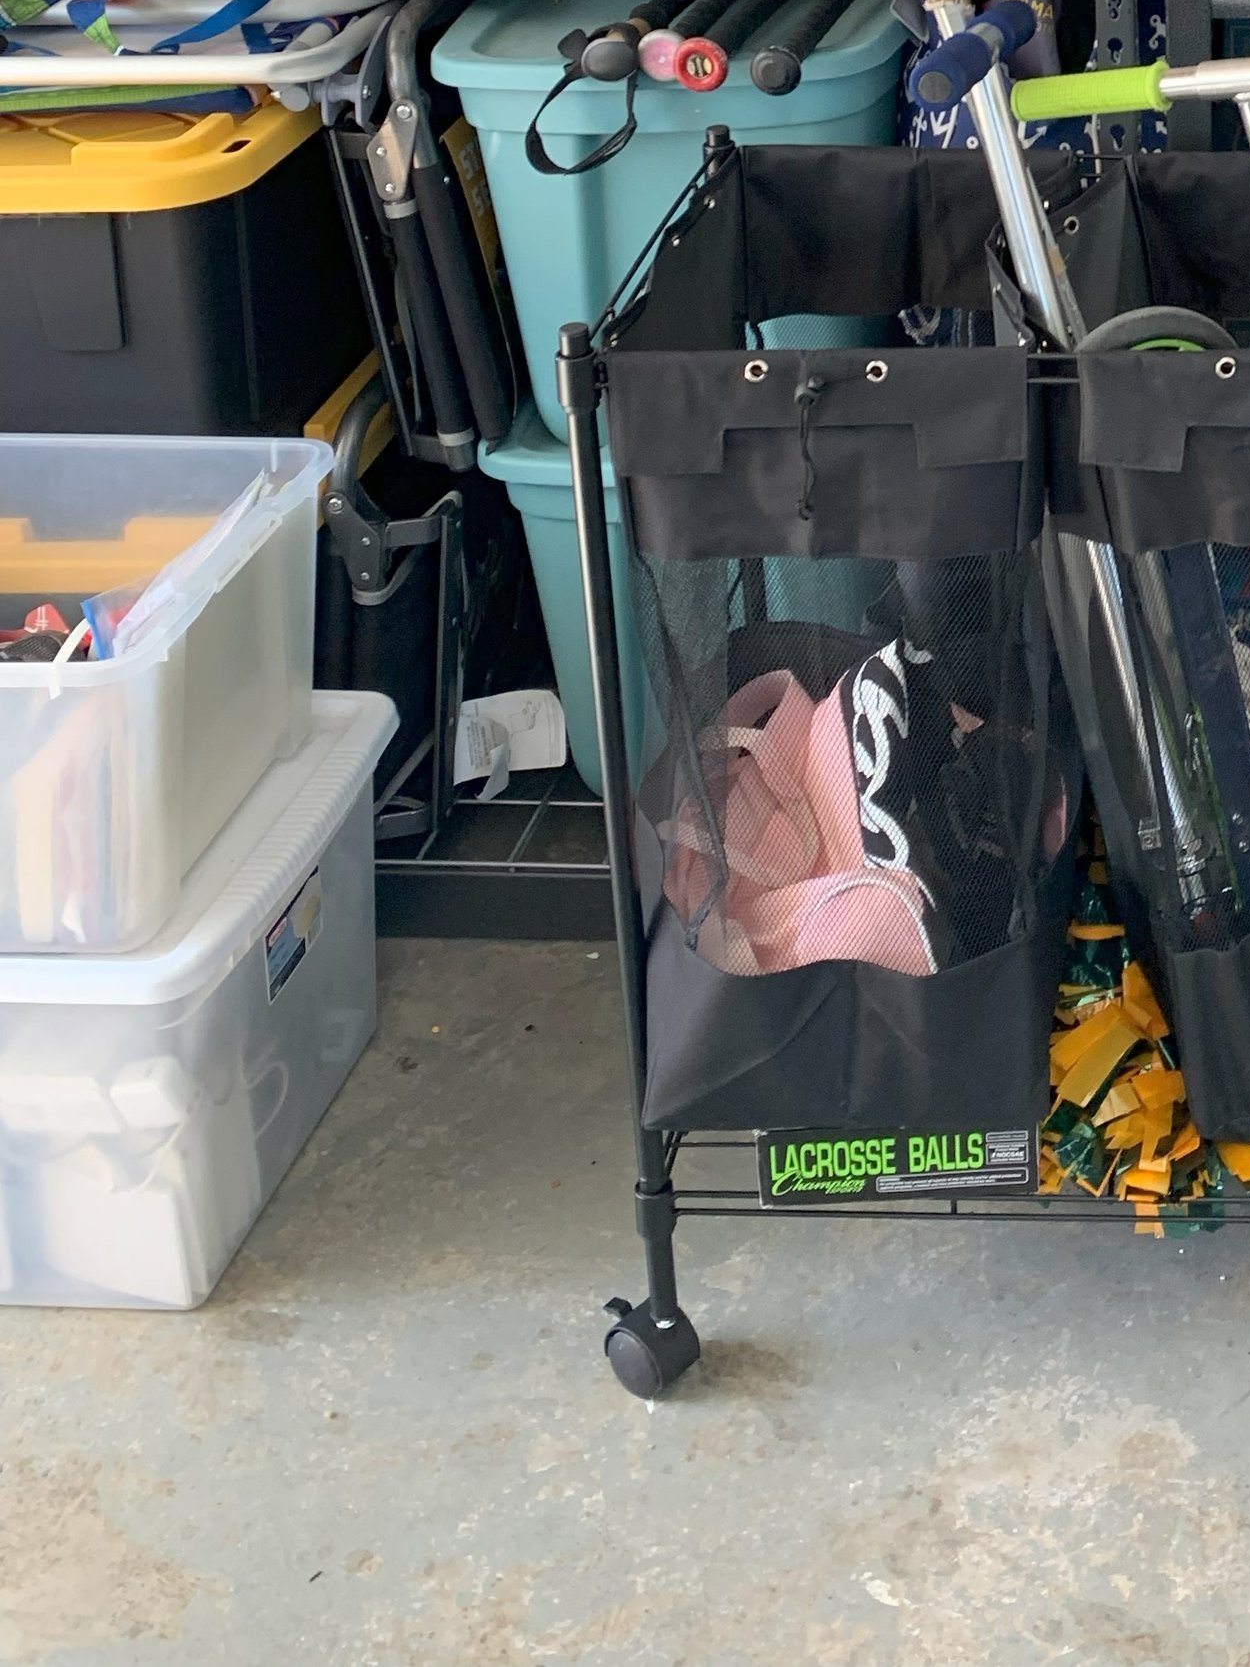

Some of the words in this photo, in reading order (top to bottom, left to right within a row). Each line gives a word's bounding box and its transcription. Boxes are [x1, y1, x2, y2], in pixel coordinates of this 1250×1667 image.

[769, 1137, 897, 1182] LACROSSE
[908, 1132, 984, 1174] BALLS
[771, 1170, 867, 1197] Champion
